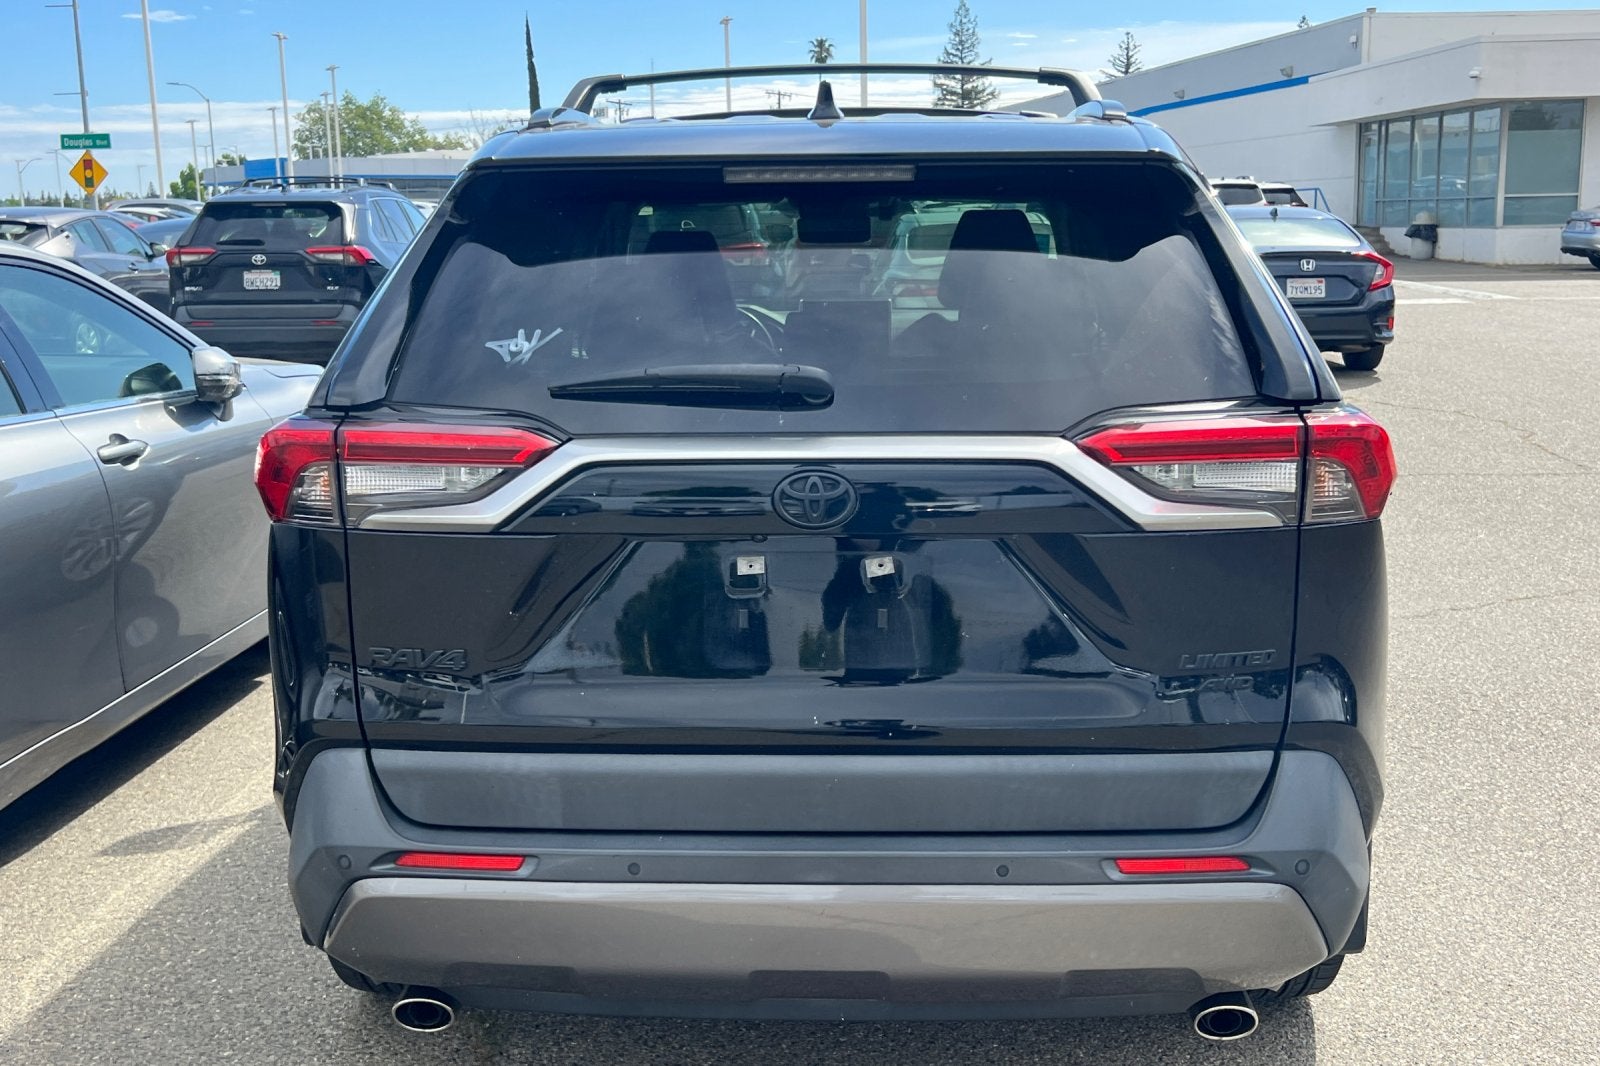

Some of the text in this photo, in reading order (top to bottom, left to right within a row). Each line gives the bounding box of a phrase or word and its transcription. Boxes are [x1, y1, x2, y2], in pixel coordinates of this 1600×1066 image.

[63, 137, 93, 148] Douglas
[368, 646, 467, 670] RAV4
[1178, 649, 1277, 670] LIMITED
[1198, 675, 1255, 692] AWD
